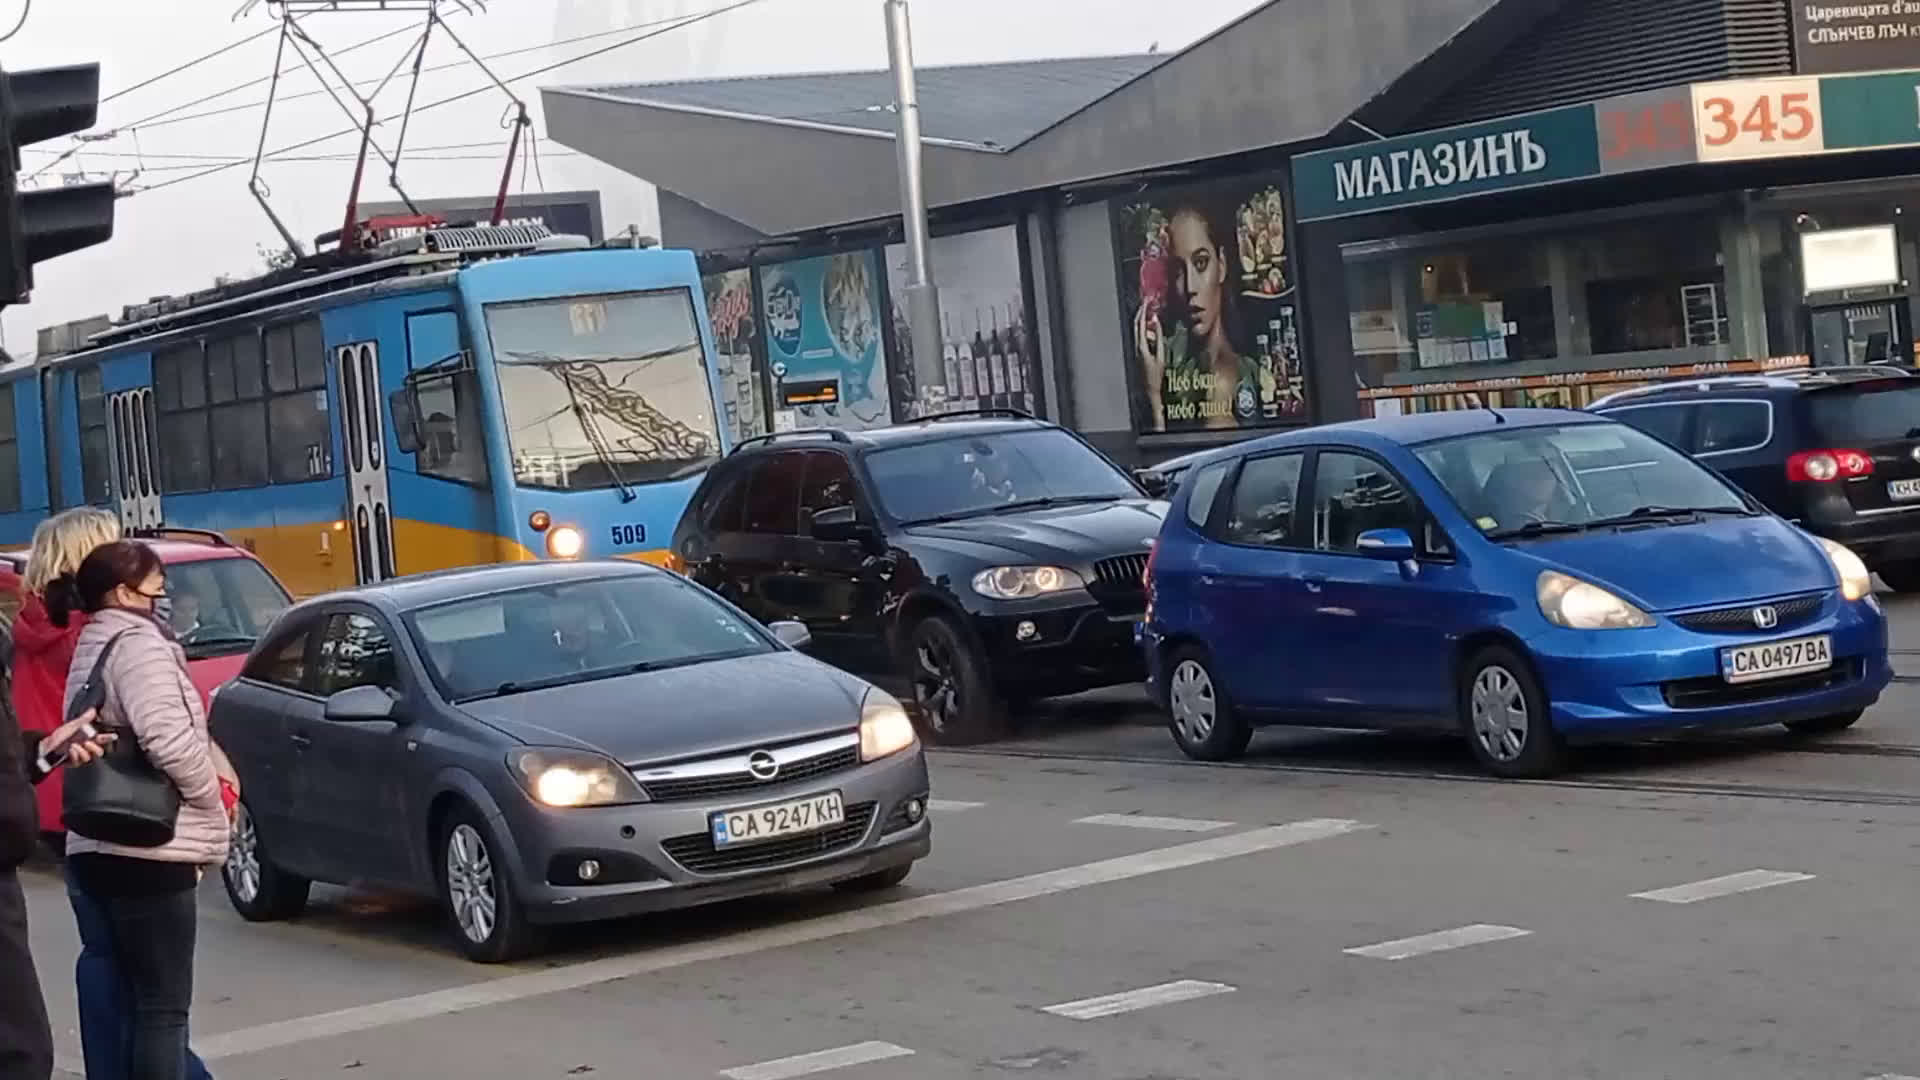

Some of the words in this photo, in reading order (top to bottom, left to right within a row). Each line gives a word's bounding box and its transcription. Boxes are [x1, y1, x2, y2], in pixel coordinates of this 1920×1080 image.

[1805, 4, 1889, 22] Царевицата
[1808, 25, 1875, 43] СЛЪНЧЕВ
[1879, 24, 1907, 38] ЛЪЧ
[1703, 93, 1814, 147] 345
[1333, 129, 1547, 201] МАГАЗИНЪ
[1165, 369, 1191, 393] Нов
[1166, 398, 1196, 420] ново
[611, 524, 646, 545] 509
[1734, 651, 1759, 672] CA
[1761, 643, 1803, 668] 0497
[1805, 640, 1829, 662] BA
[728, 813, 760, 838] CA
[763, 803, 812, 833] 9247
[814, 797, 841, 823] KH
